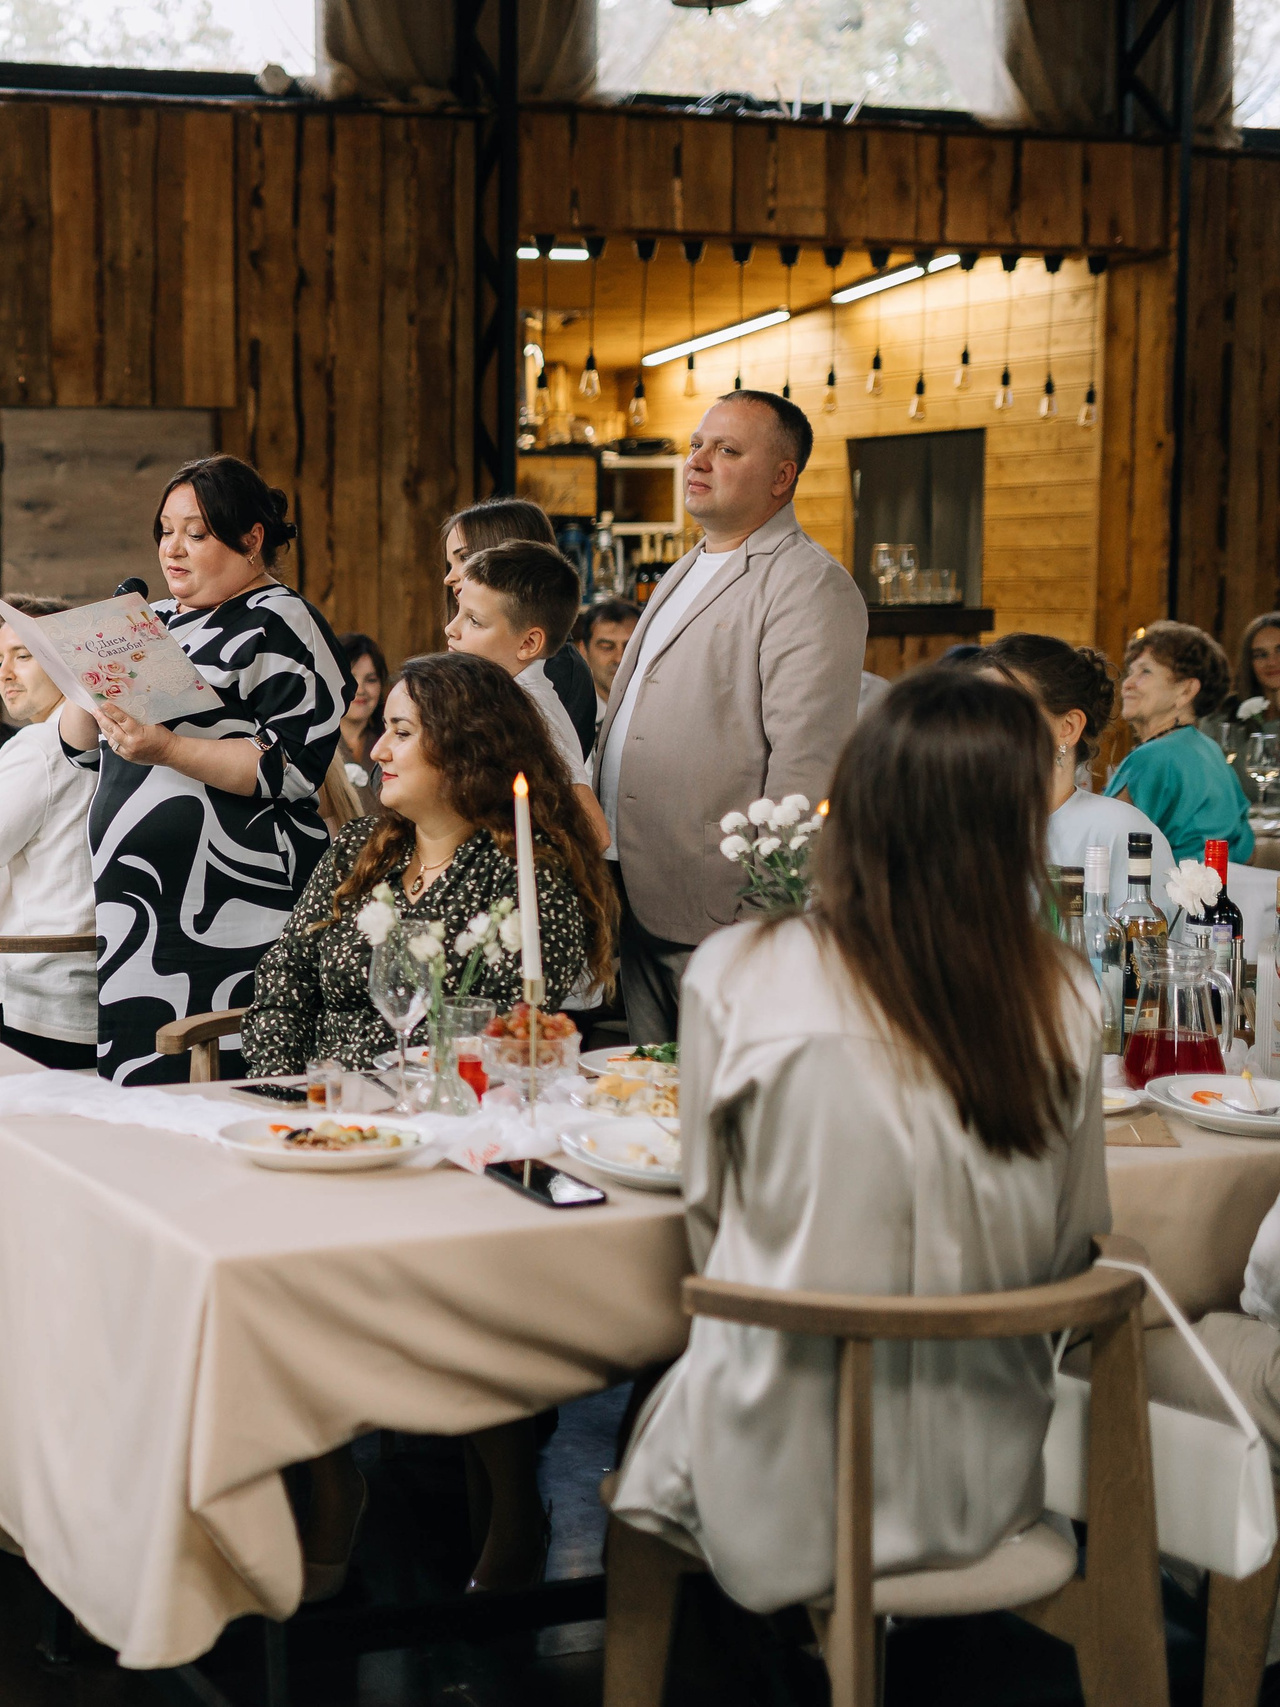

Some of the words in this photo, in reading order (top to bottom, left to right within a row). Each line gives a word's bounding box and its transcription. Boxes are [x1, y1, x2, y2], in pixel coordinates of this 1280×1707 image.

[85, 640, 98, 653] С
[97, 636, 127, 649] Днем
[98, 639, 146, 658] Свадьбы!
